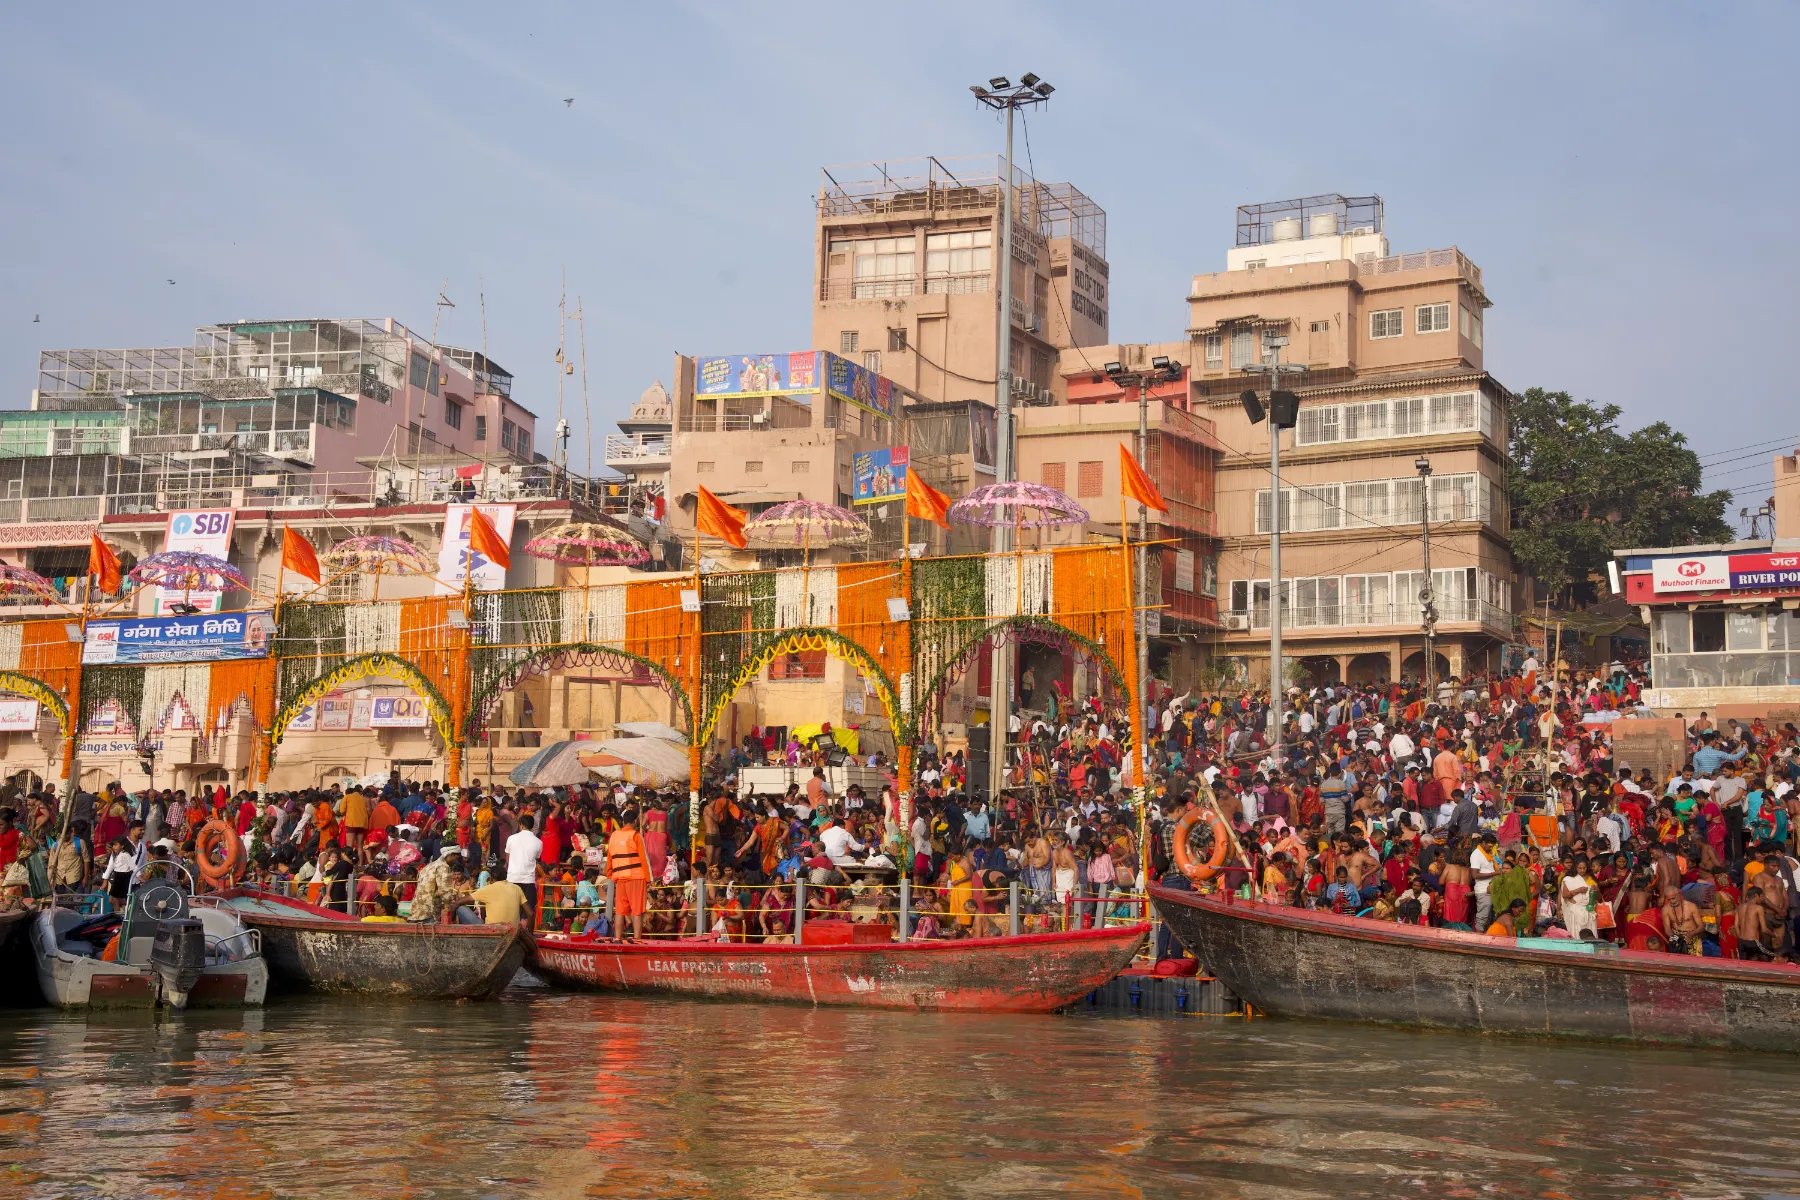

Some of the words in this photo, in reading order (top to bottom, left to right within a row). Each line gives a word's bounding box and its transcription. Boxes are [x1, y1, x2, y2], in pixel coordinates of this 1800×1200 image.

[193, 513, 230, 534] SBI
[1770, 557, 1798, 566] जल
[1738, 573, 1776, 585] RIVER
[123, 623, 161, 639] गंगा
[165, 621, 199, 638] सेवा
[203, 617, 242, 635] निधि
[335, 701, 348, 711] LIC
[397, 699, 422, 716] LIC
[110, 740, 137, 752] Seva
[1590, 801, 1599, 813] Z
[648, 960, 679, 973] LEAK
[681, 961, 724, 974] PROOF
[728, 978, 772, 991] HOMES
